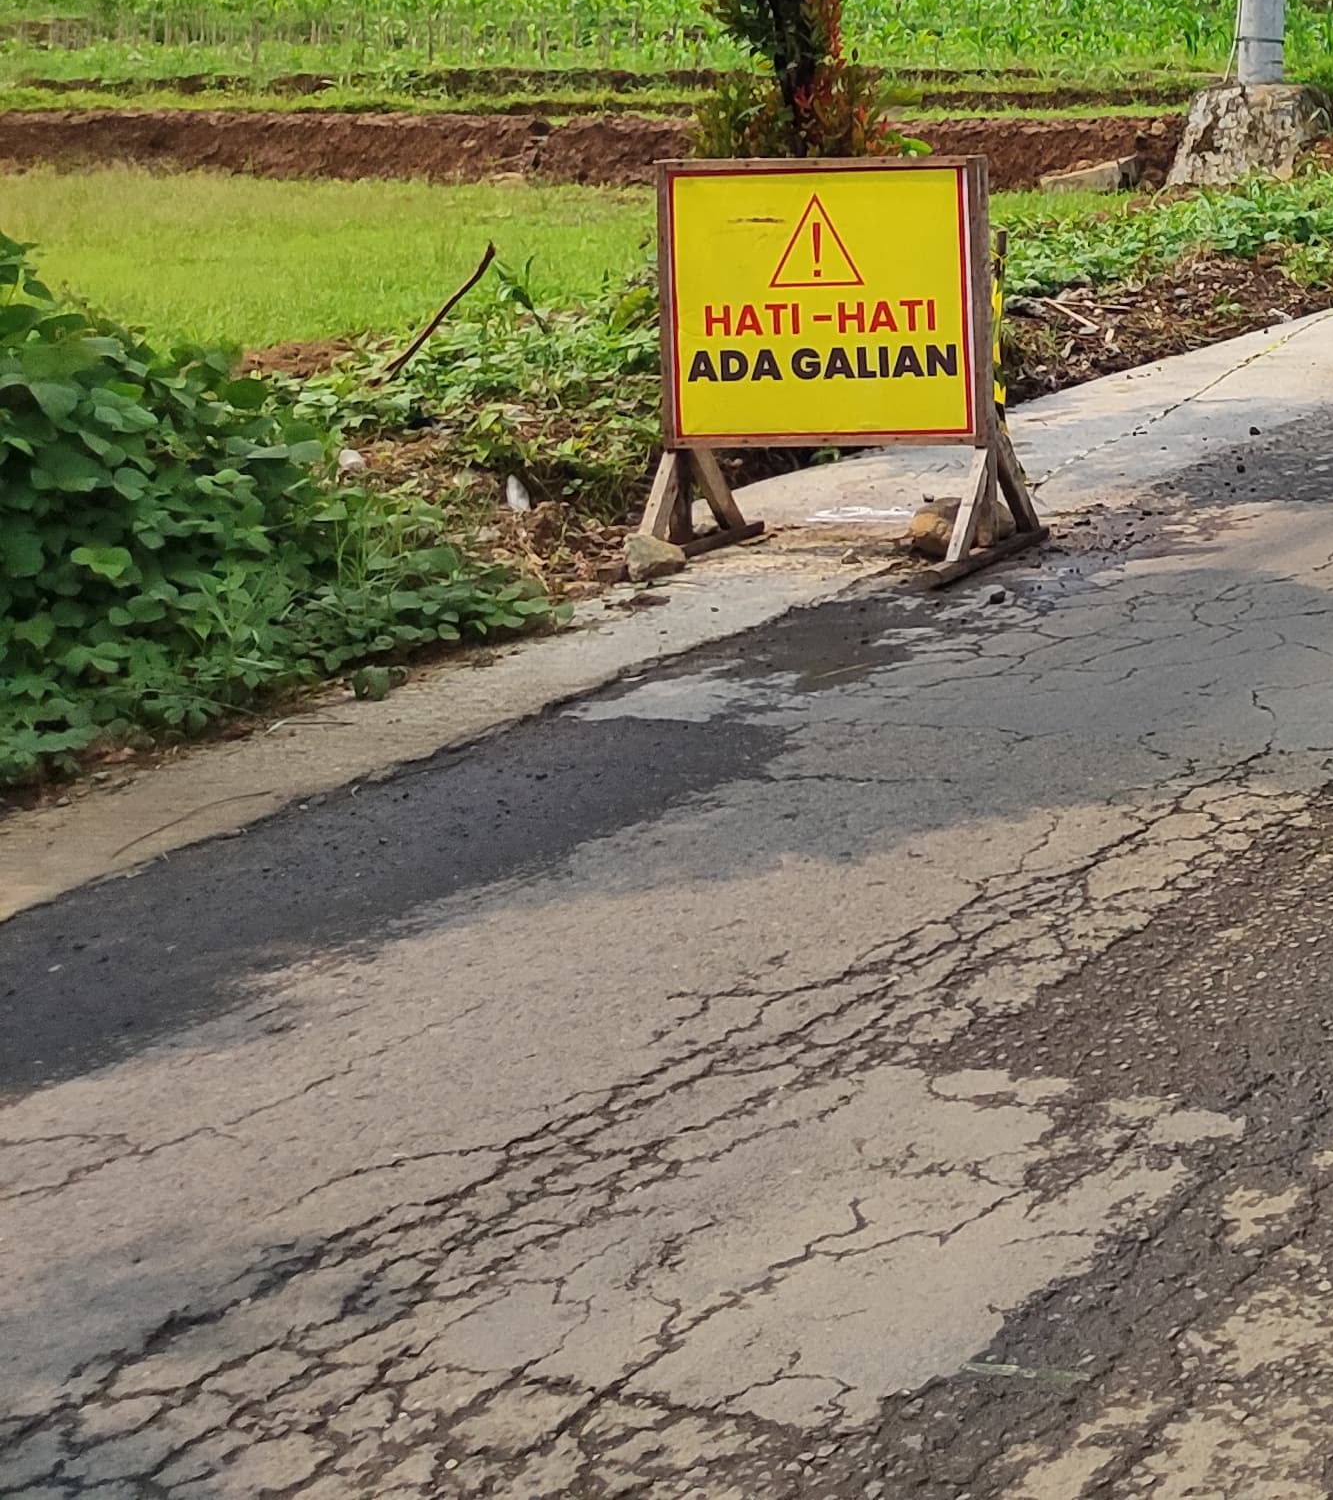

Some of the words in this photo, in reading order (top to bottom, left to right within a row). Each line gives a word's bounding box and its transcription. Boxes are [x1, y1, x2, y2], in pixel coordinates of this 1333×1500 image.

[704, 299, 936, 337] HATI-HATI
[687, 348, 783, 382] ADA
[791, 343, 958, 380] GALIAN
